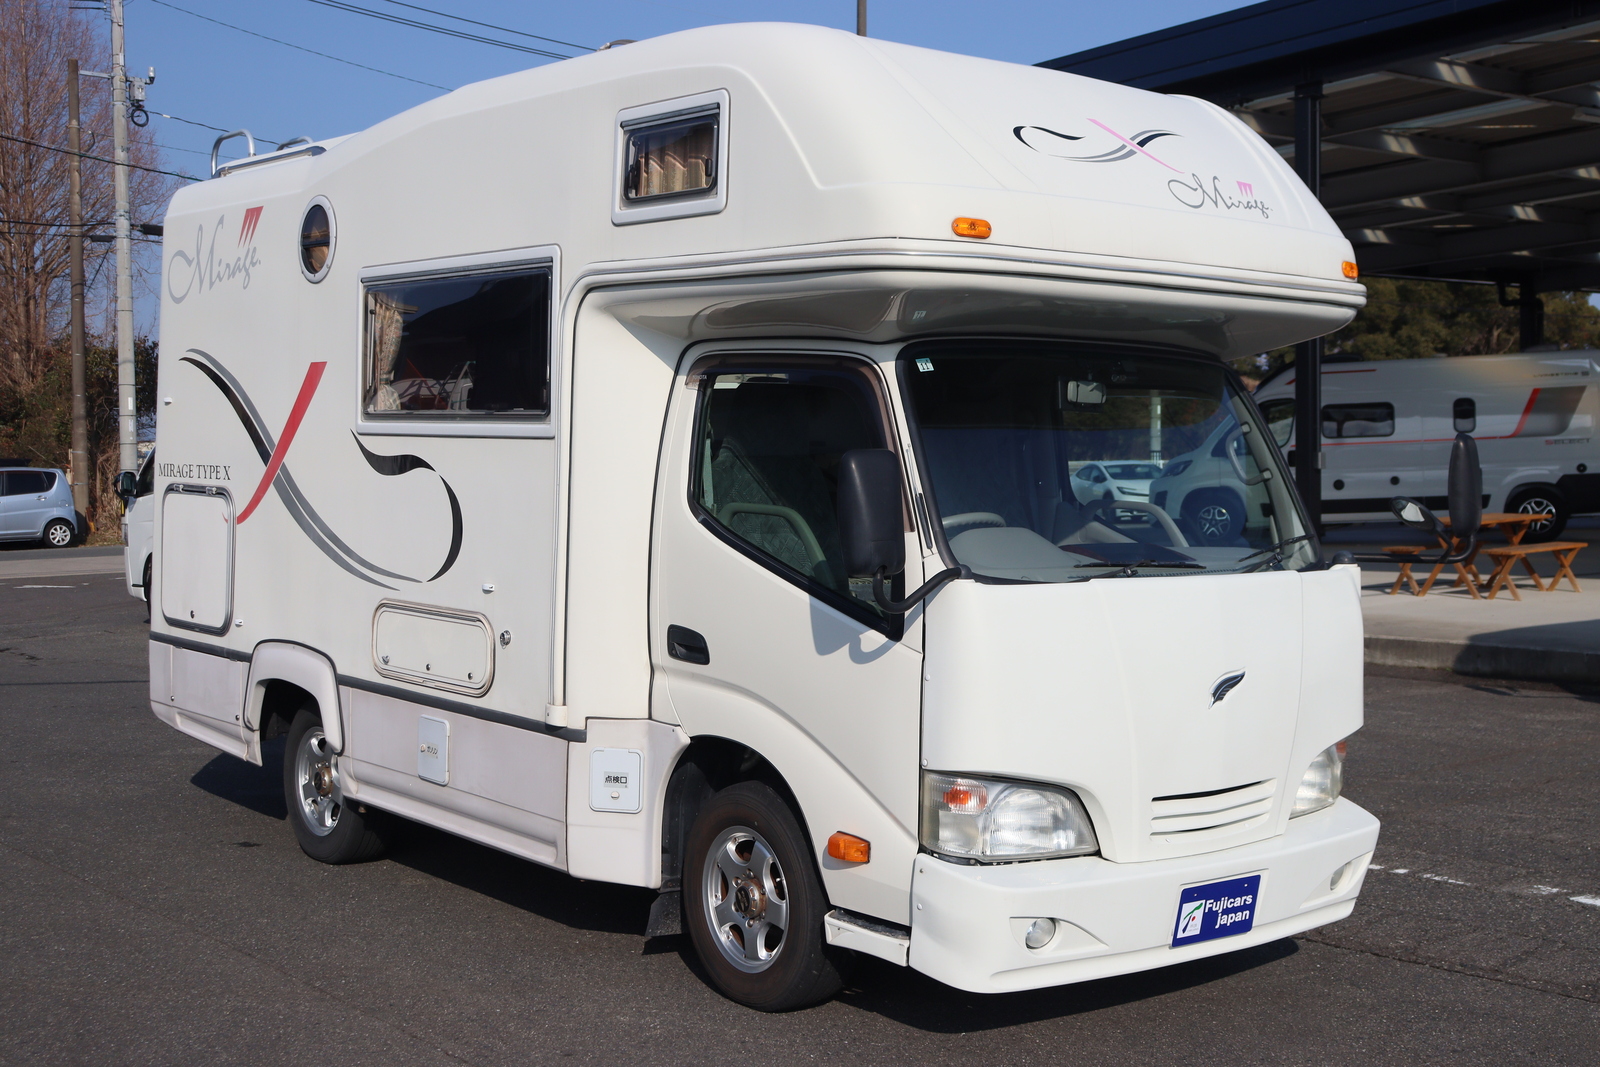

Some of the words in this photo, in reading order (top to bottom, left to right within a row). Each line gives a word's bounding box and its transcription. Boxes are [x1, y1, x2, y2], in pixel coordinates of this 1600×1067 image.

[158, 463, 194, 479] MIRAGE
[196, 464, 221, 480] TYPE
[223, 465, 231, 481] X
[604, 774, 628, 785] 点検口
[1204, 894, 1253, 914] Fujicars
[1214, 909, 1250, 929] japan
